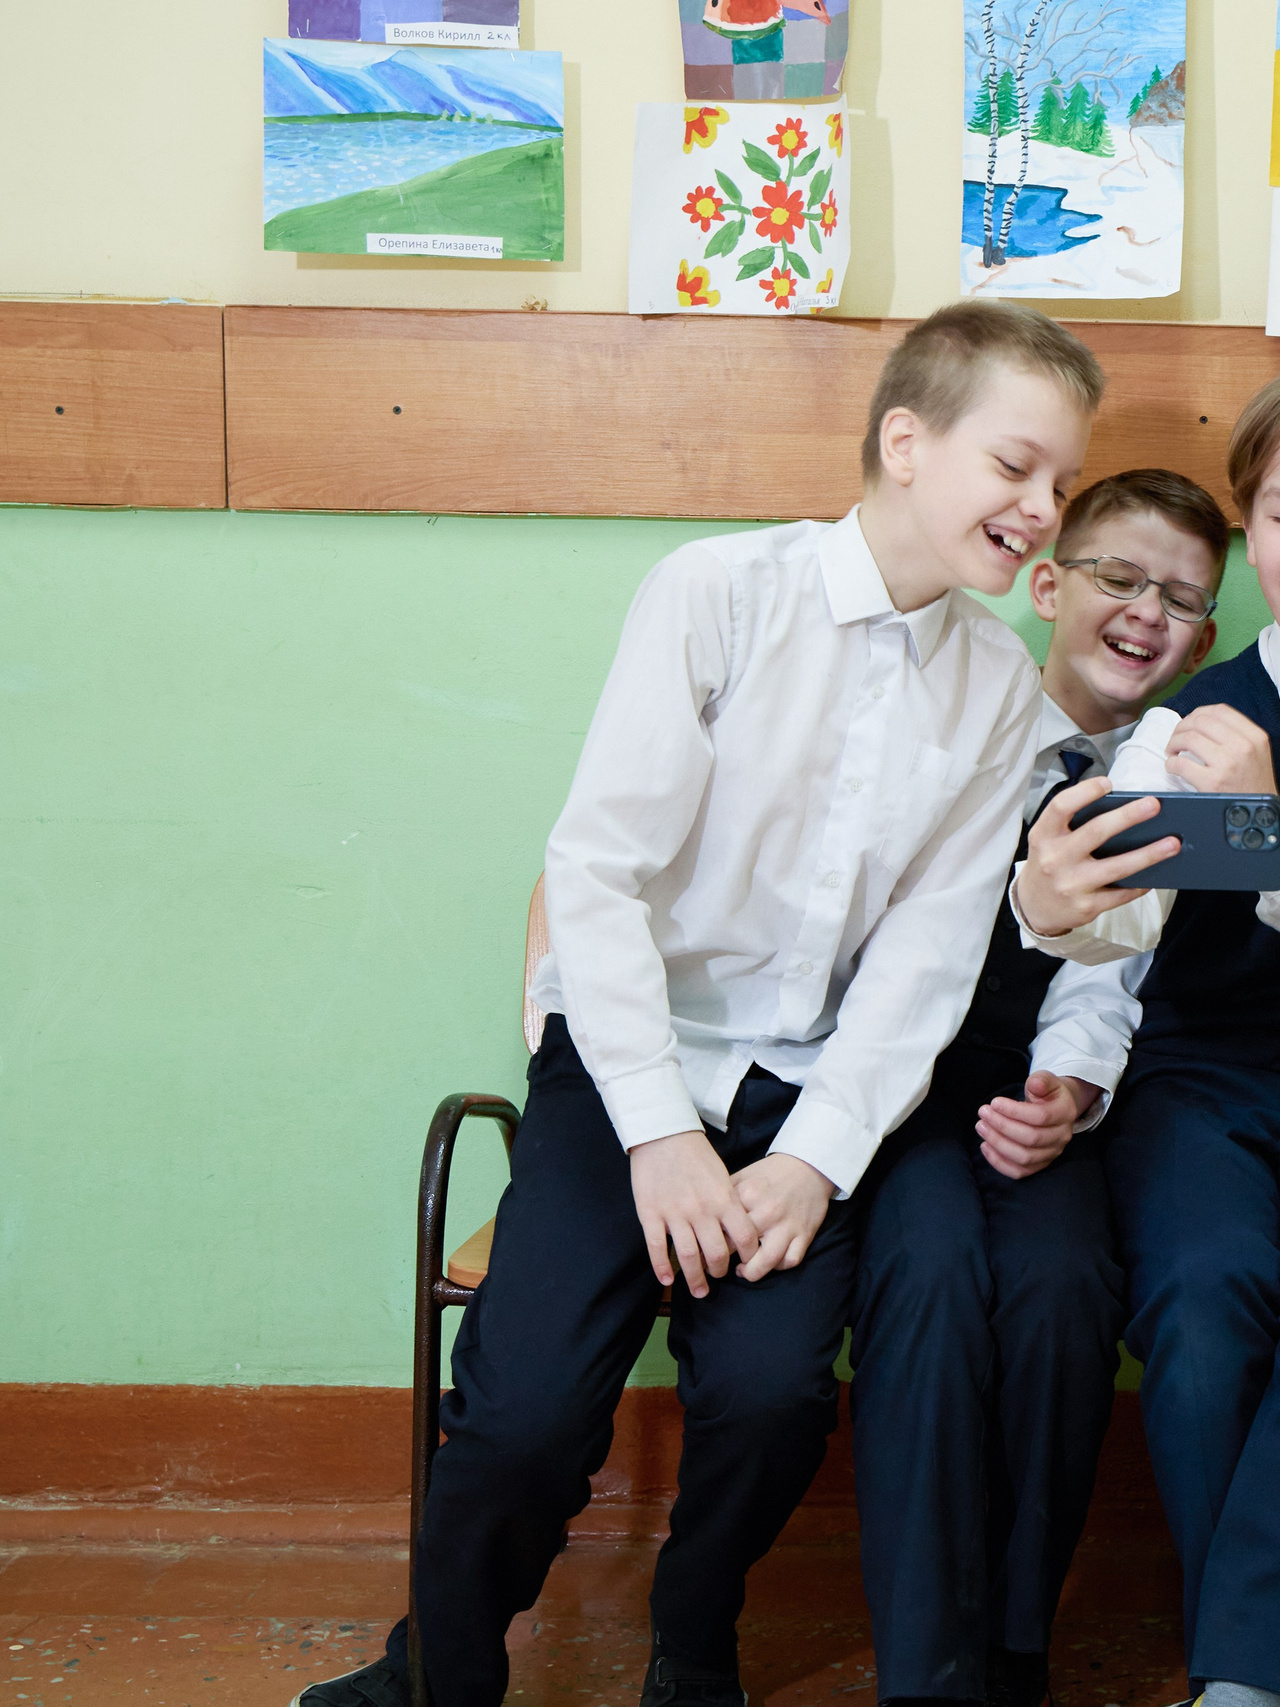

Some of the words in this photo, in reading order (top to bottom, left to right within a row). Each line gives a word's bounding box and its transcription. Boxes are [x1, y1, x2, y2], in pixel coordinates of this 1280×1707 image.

[394, 28, 435, 39] Волков
[438, 30, 481, 41] Кирилл
[487, 31, 495, 40] 2
[379, 237, 429, 249] Орепина
[432, 239, 490, 252] Елизавета
